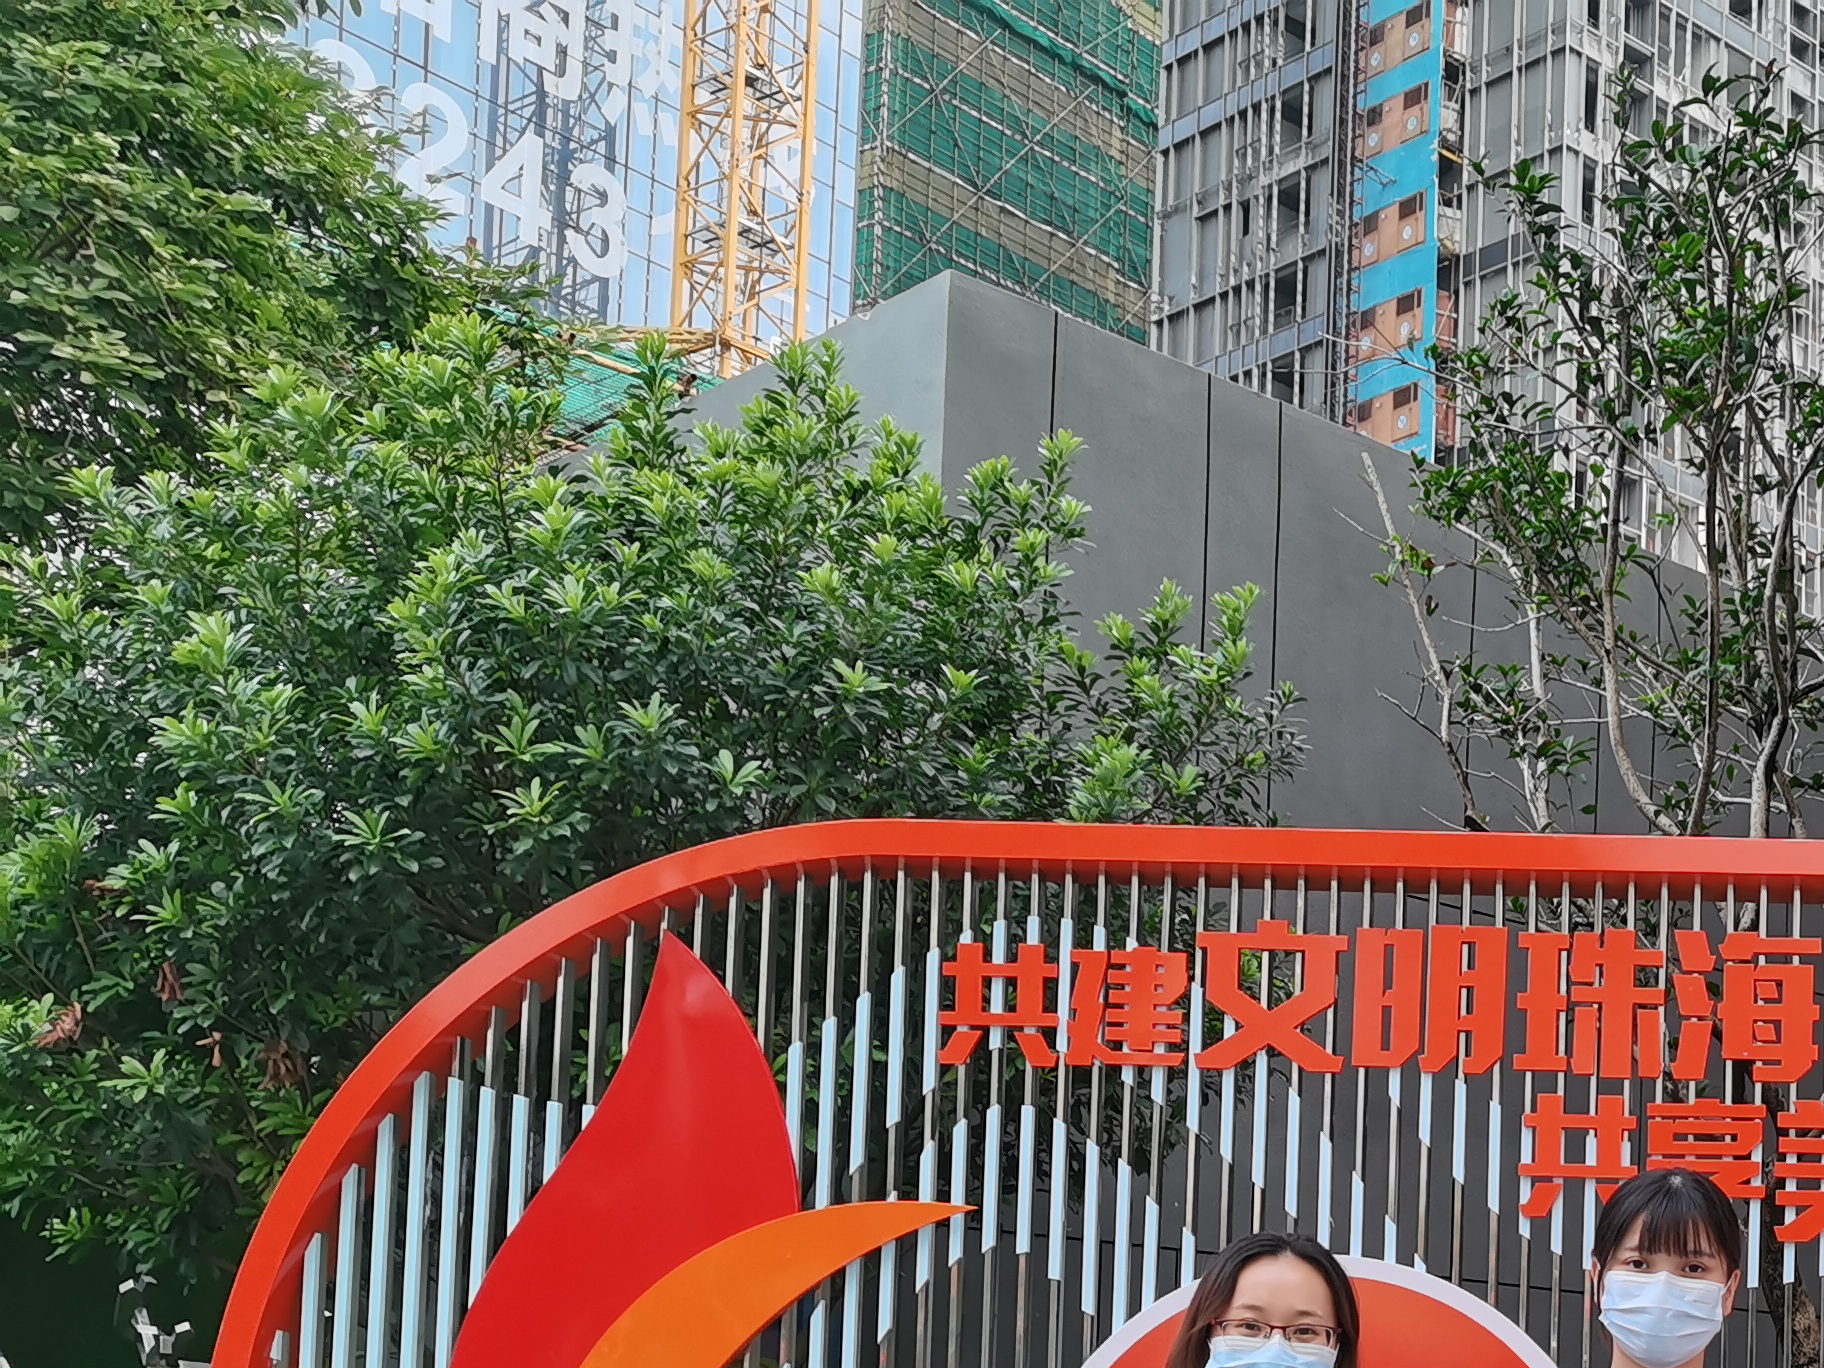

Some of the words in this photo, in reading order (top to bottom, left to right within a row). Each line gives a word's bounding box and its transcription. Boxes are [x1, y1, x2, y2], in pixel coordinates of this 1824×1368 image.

[938, 920, 1822, 1082] 共建文明珠海
